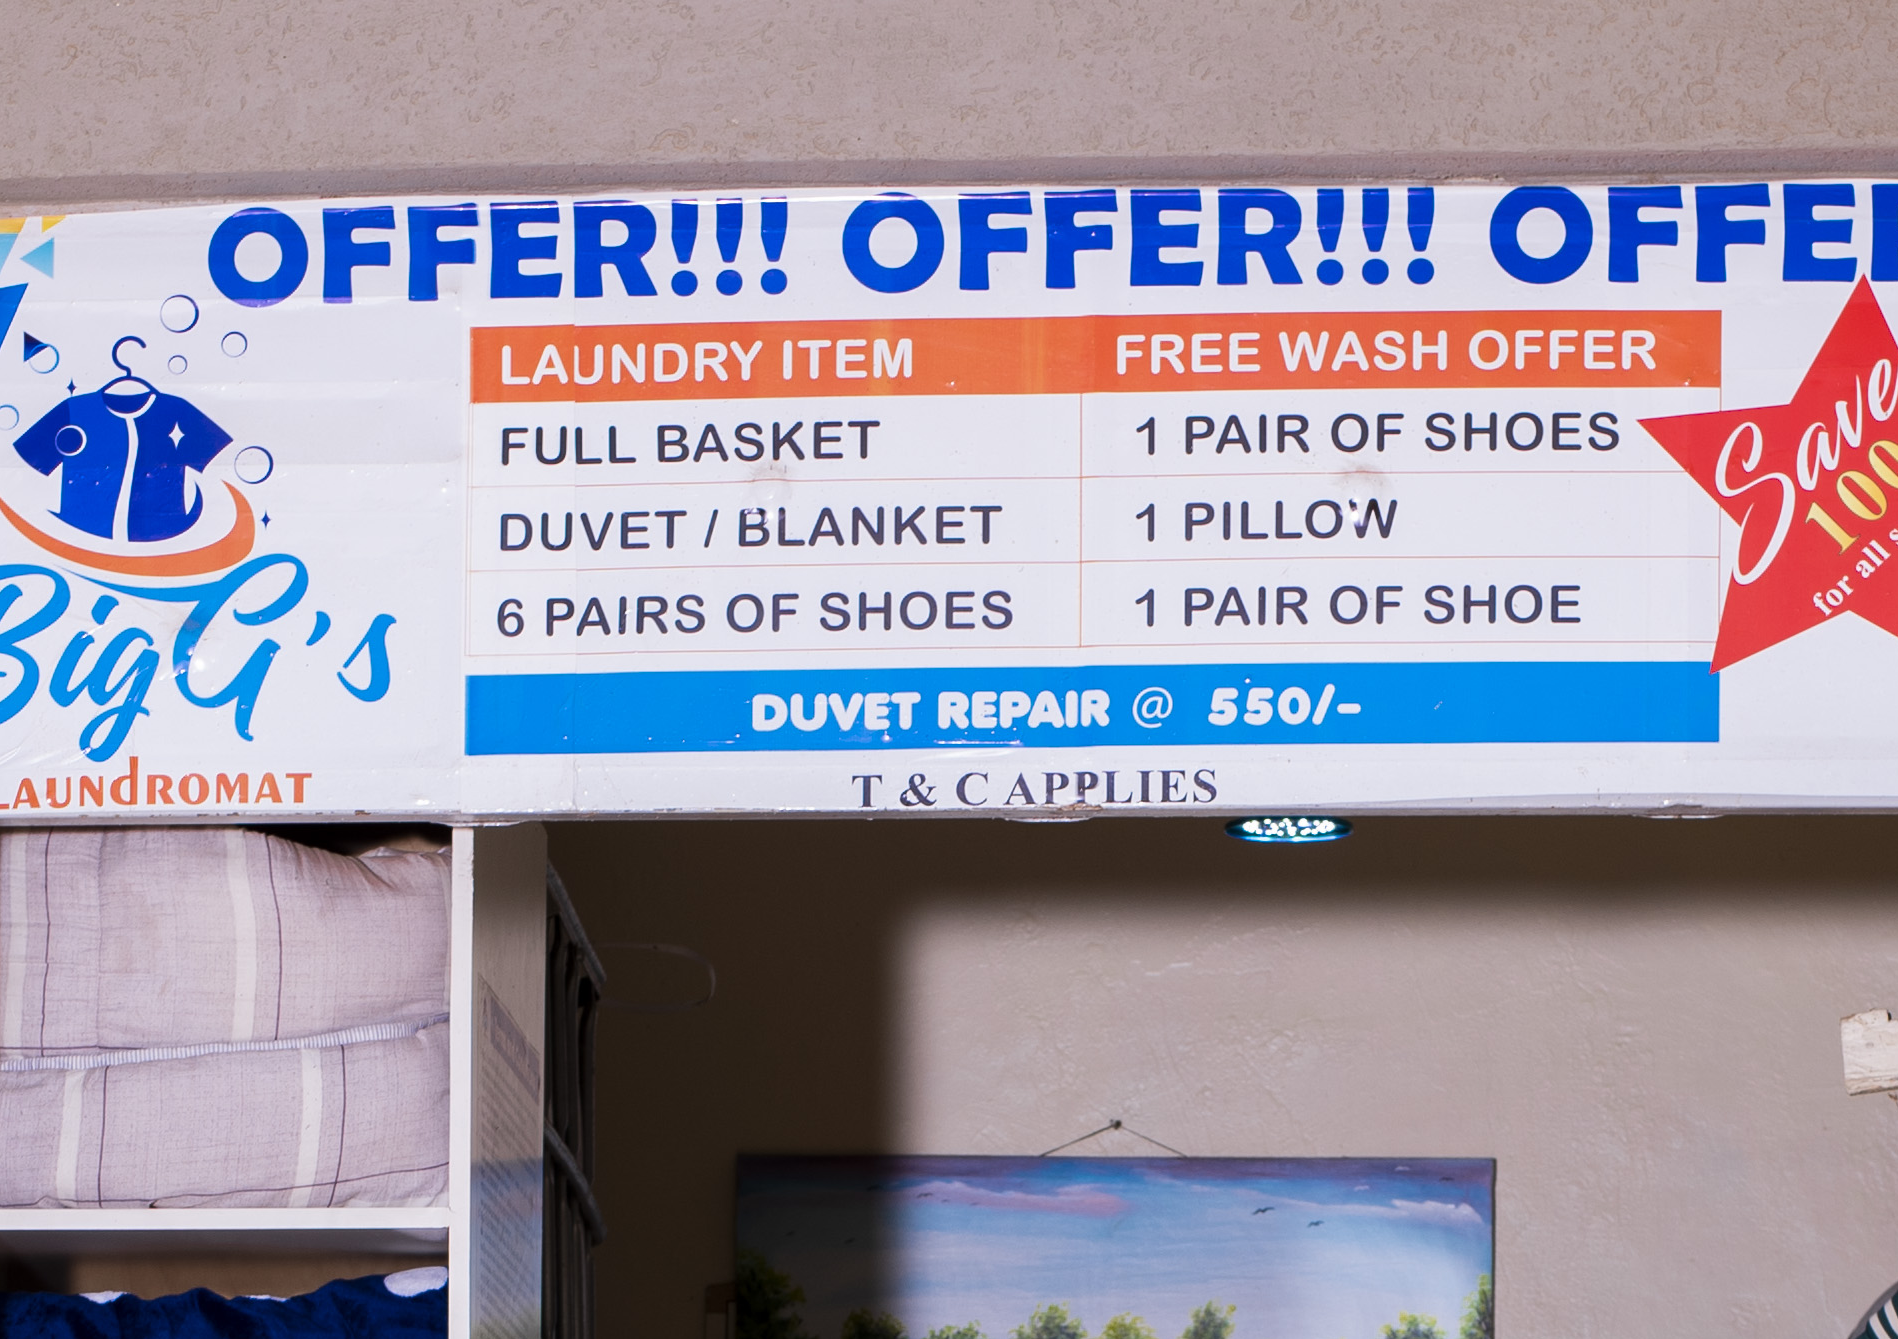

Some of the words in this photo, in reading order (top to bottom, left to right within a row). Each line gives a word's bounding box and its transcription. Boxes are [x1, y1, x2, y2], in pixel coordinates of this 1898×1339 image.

[208, 197, 788, 308] OFFER!!!
[842, 187, 1435, 294] OFFER!!!
[501, 339, 762, 385] LAUNDRY
[784, 337, 914, 380] ITEM
[1116, 332, 1261, 374] FREE
[1279, 330, 1448, 372] WASH
[1469, 329, 1657, 371] OFFER
[501, 425, 637, 466] FULL
[657, 420, 881, 463] BASKET
[1136, 416, 1155, 456] 1
[1185, 414, 1310, 455] PAIR
[1330, 413, 1405, 453] OF
[1424, 411, 1620, 452] SHOES
[500, 510, 686, 552] DUVET
[703, 509, 719, 548] /
[738, 505, 1003, 547] BLANKET
[1136, 503, 1155, 542] 1
[1184, 498, 1398, 542] PILLOW
[1813, 574, 1853, 616] for
[1855, 539, 1891, 579] all
[497, 598, 525, 638] 6
[546, 594, 706, 637] PAIRS
[726, 593, 800, 633] OF
[819, 590, 1013, 633] SHOES
[1136, 588, 1155, 627] 1
[1184, 586, 1309, 627] PAIR
[1329, 585, 1404, 625] OF
[1423, 584, 1581, 625] SHOE
[752, 692, 921, 731] DUVET
[938, 690, 1110, 729] REPAIR
[1133, 687, 1173, 728] @
[1209, 684, 1362, 726] 550/-
[852, 774, 883, 808] T
[900, 773, 937, 806] &
[956, 772, 989, 806] C
[1004, 769, 1217, 805] APPLIES
